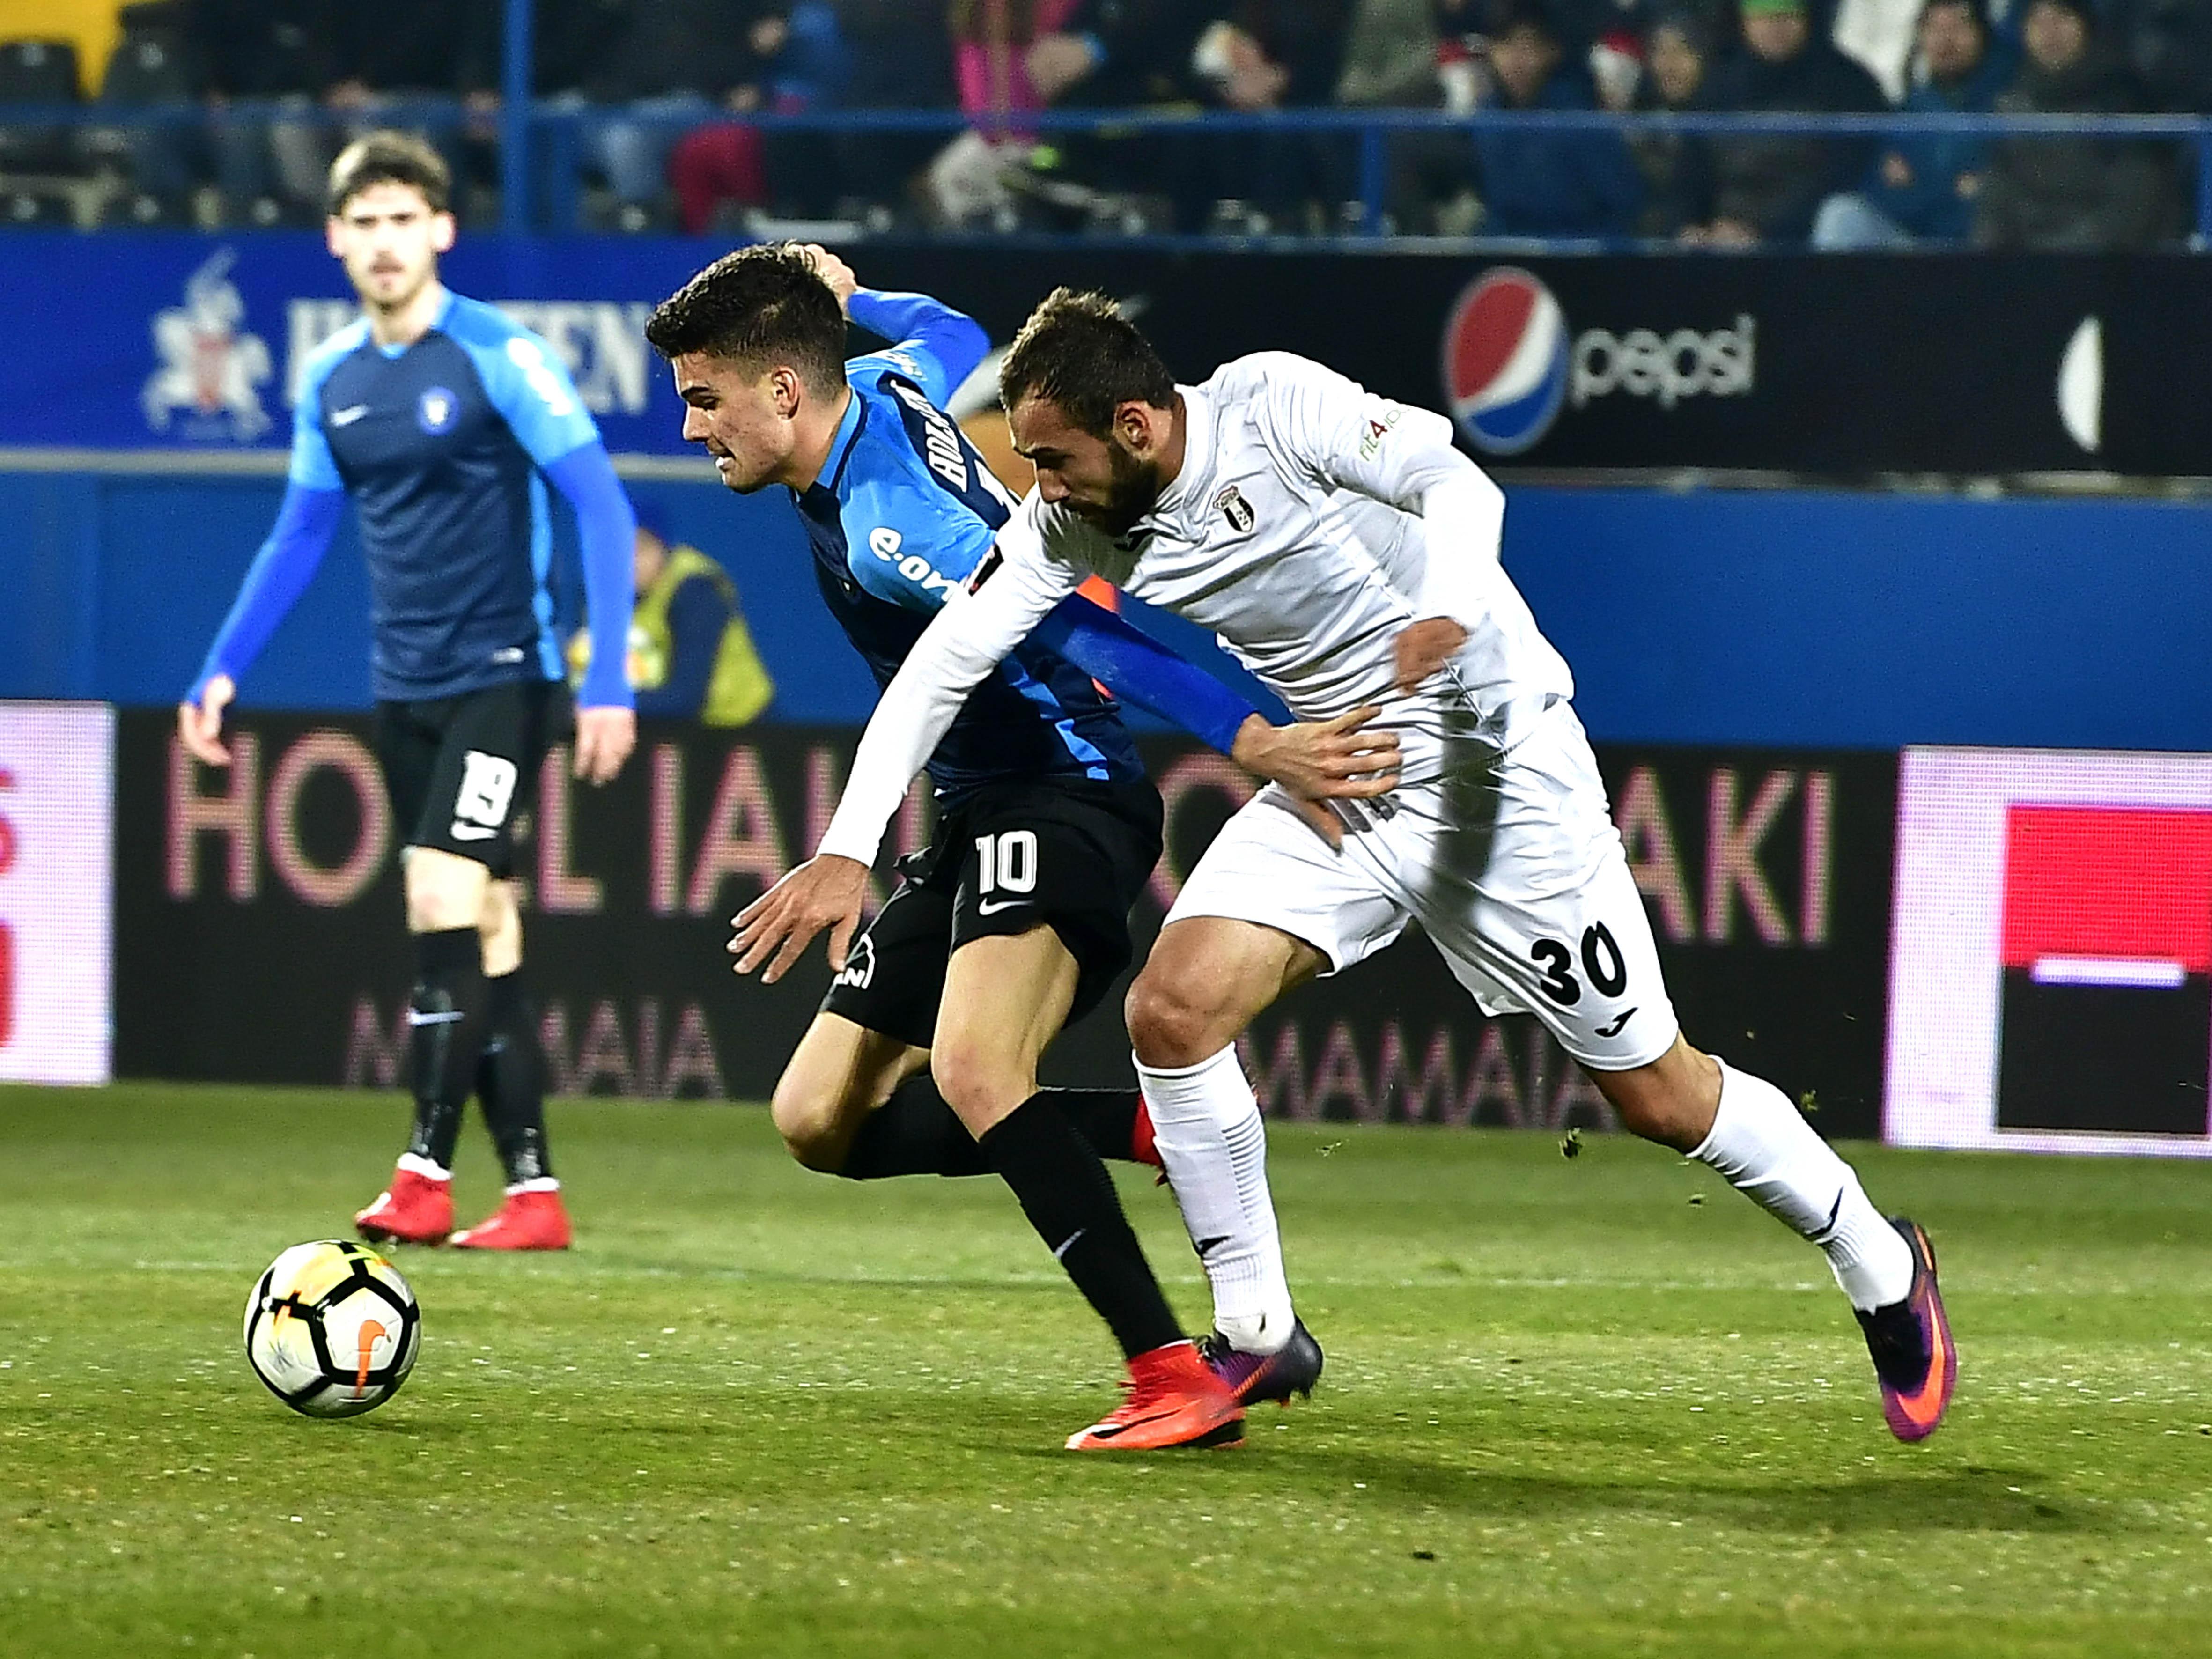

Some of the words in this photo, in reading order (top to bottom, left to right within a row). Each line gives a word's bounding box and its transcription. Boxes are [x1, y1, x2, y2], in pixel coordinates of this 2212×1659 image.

[1572, 312, 1755, 410] pepsi
[167, 730, 605, 913] HOL
[975, 830, 1037, 895] 10
[1612, 764, 1833, 946] AKI
[1531, 920, 1627, 1006] 30
[345, 995, 725, 1099] MAIA
